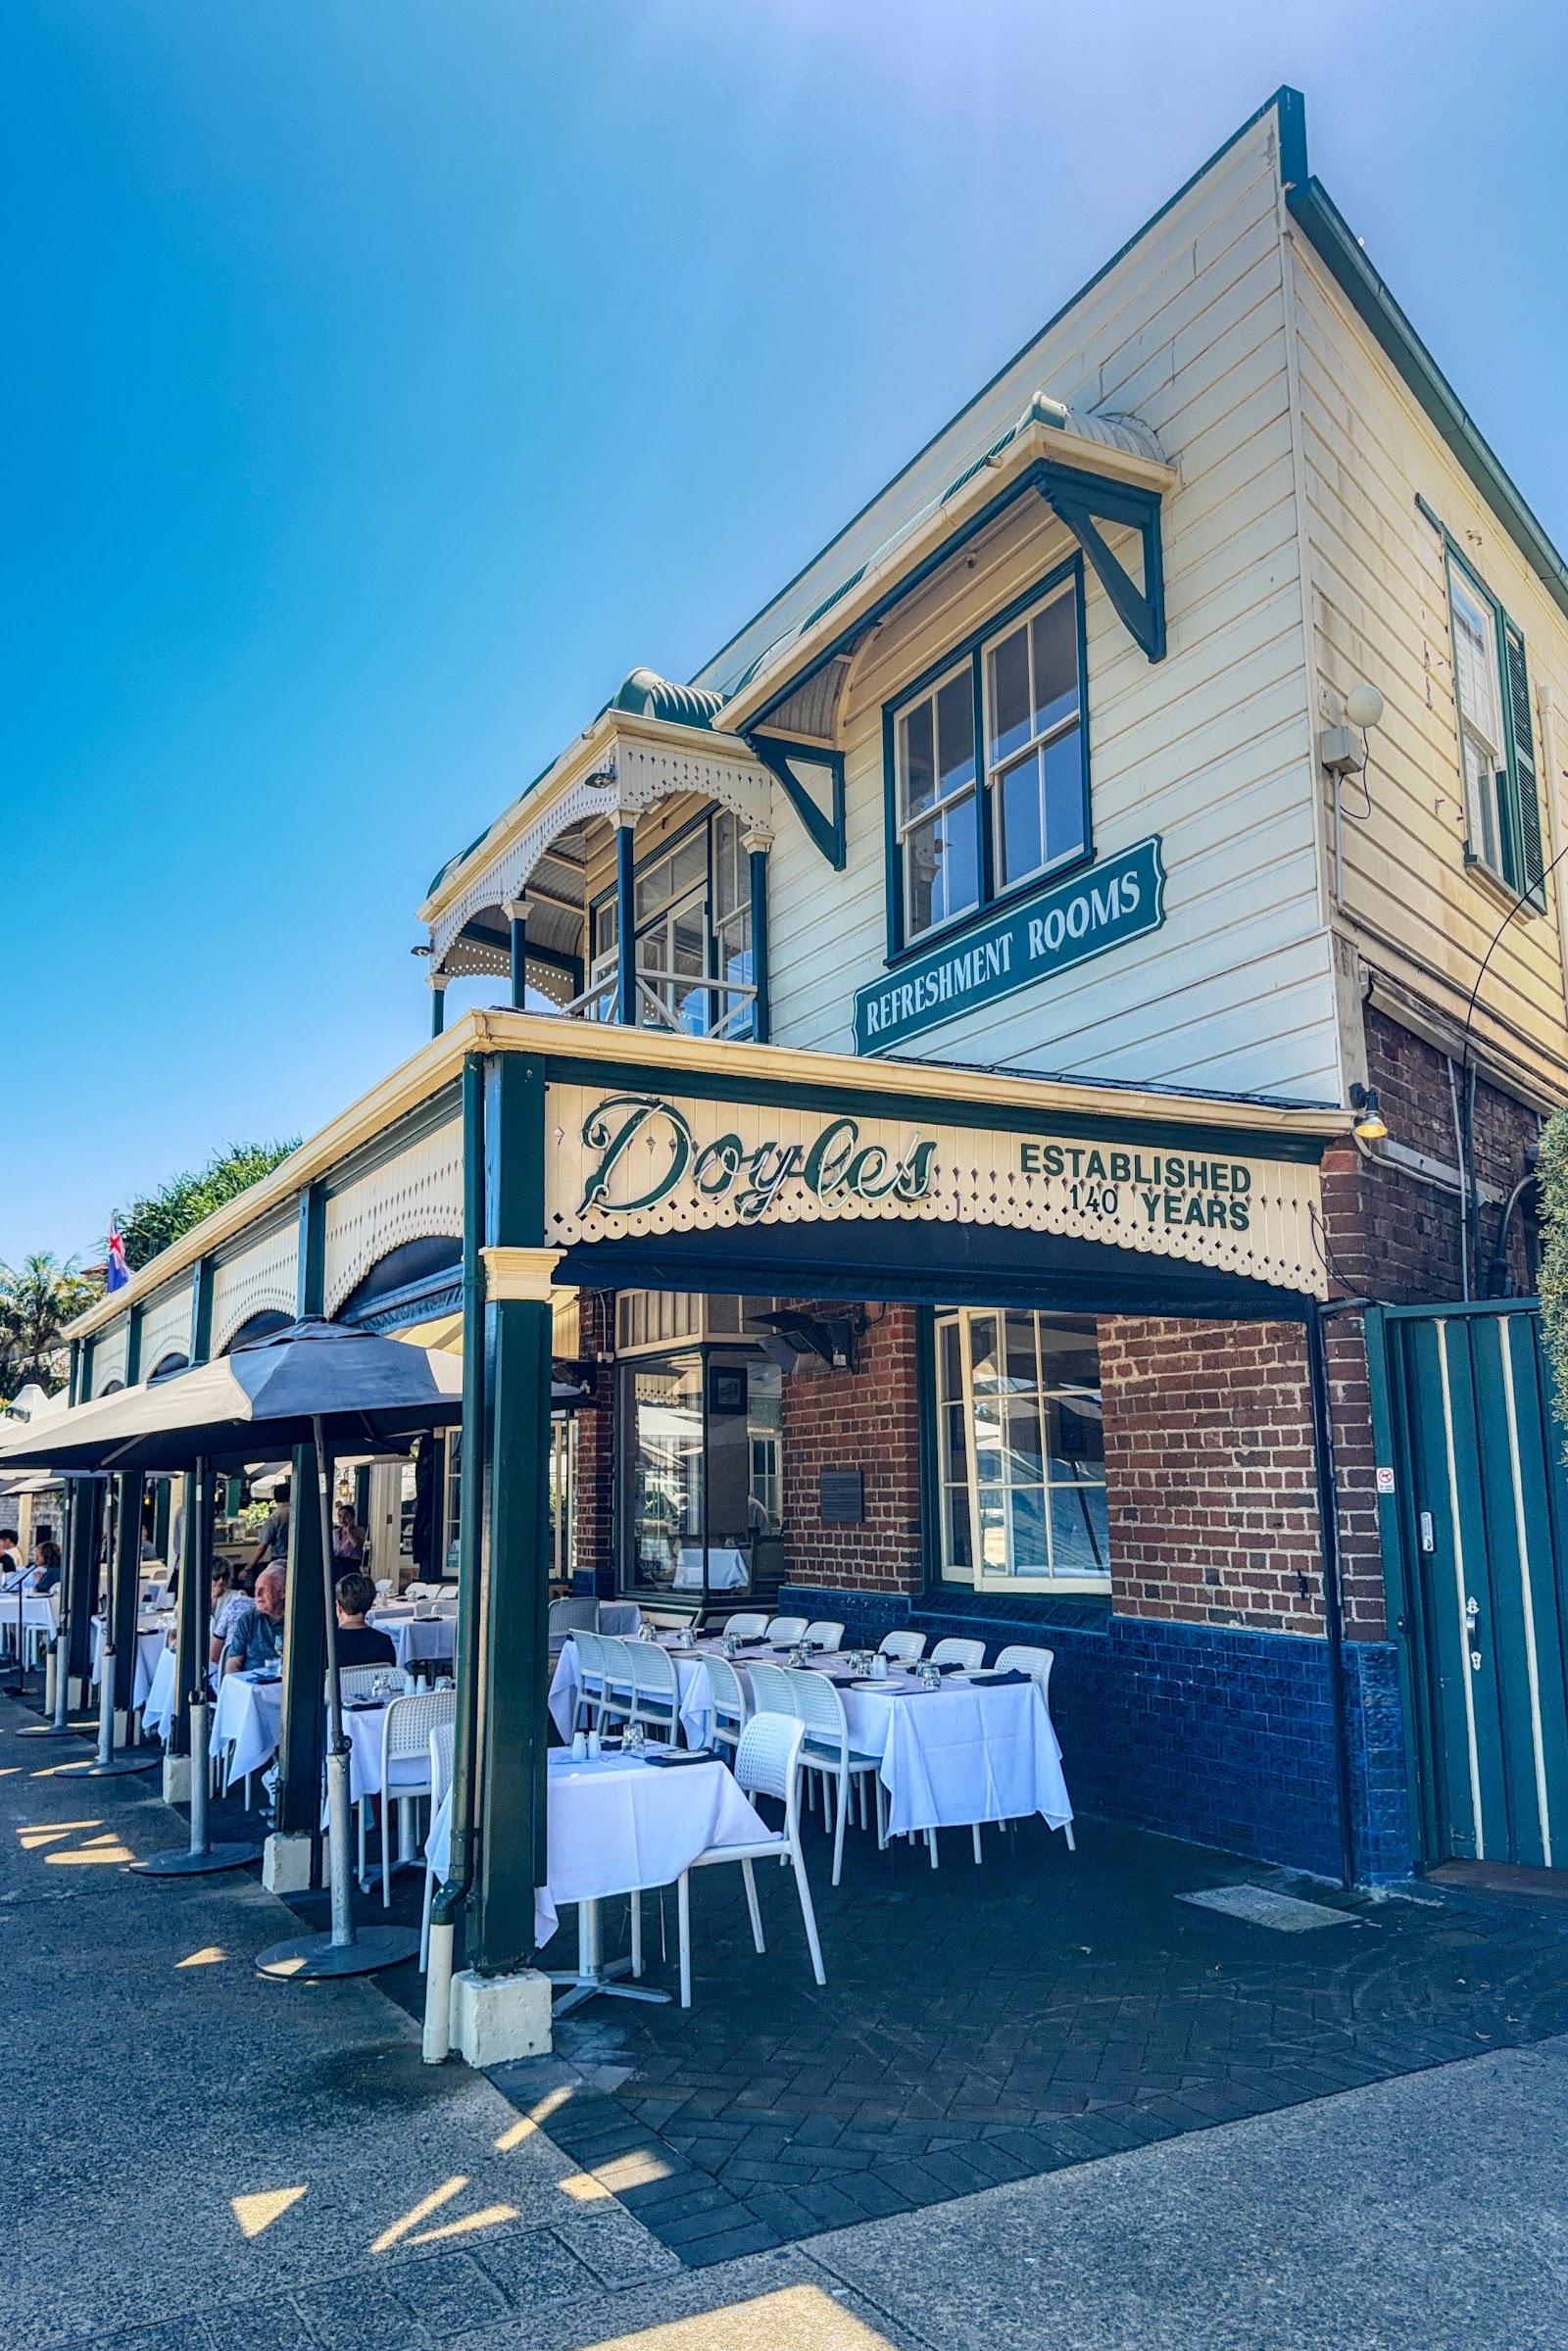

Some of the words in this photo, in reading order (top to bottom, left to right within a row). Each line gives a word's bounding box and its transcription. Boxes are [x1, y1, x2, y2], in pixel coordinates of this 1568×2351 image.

[866, 932, 1013, 1036] REFRESHMENT
[1028, 871, 1140, 960] ROOMS
[575, 1093, 938, 1226] Doyles
[1020, 1143, 1251, 1193] ESTABLISHED
[1070, 1184, 1118, 1214] 140
[1141, 1192, 1250, 1232] YEARS
